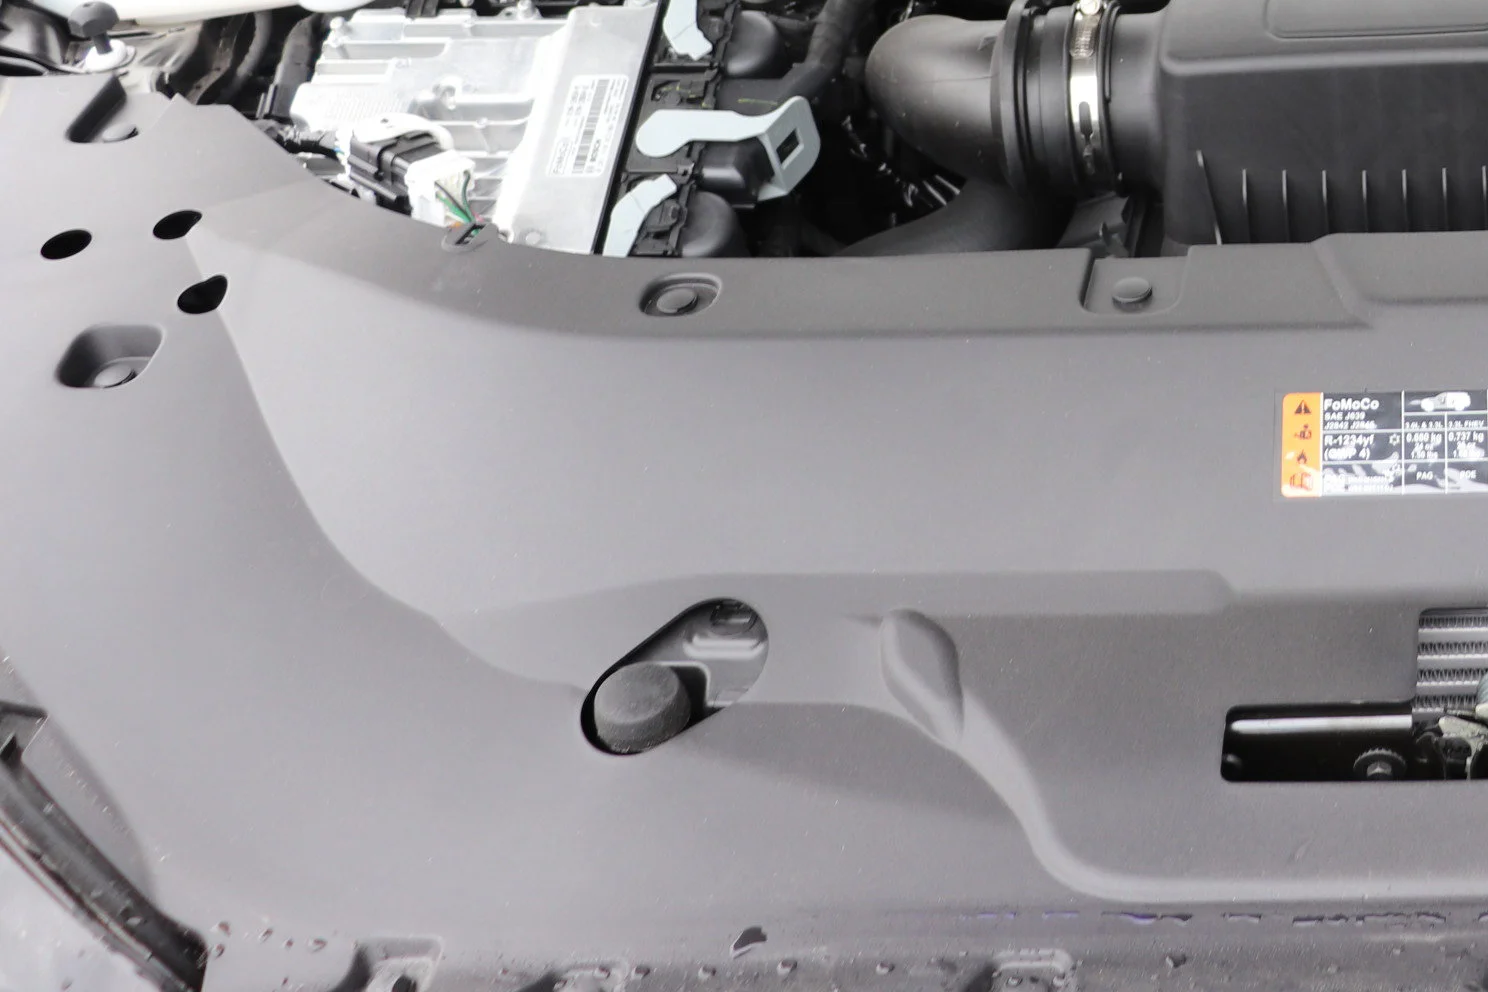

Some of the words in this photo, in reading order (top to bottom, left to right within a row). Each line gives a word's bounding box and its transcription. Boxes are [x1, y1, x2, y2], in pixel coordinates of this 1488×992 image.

[1323, 397, 1380, 411] FoMoCo
[1324, 411, 1344, 421] SAE
[1324, 434, 1375, 447] R-1234yf
[1430, 432, 1442, 445] kg
[1472, 430, 1484, 443] kg
[1416, 471, 1434, 480] PAG
[1460, 469, 1477, 479] POE
